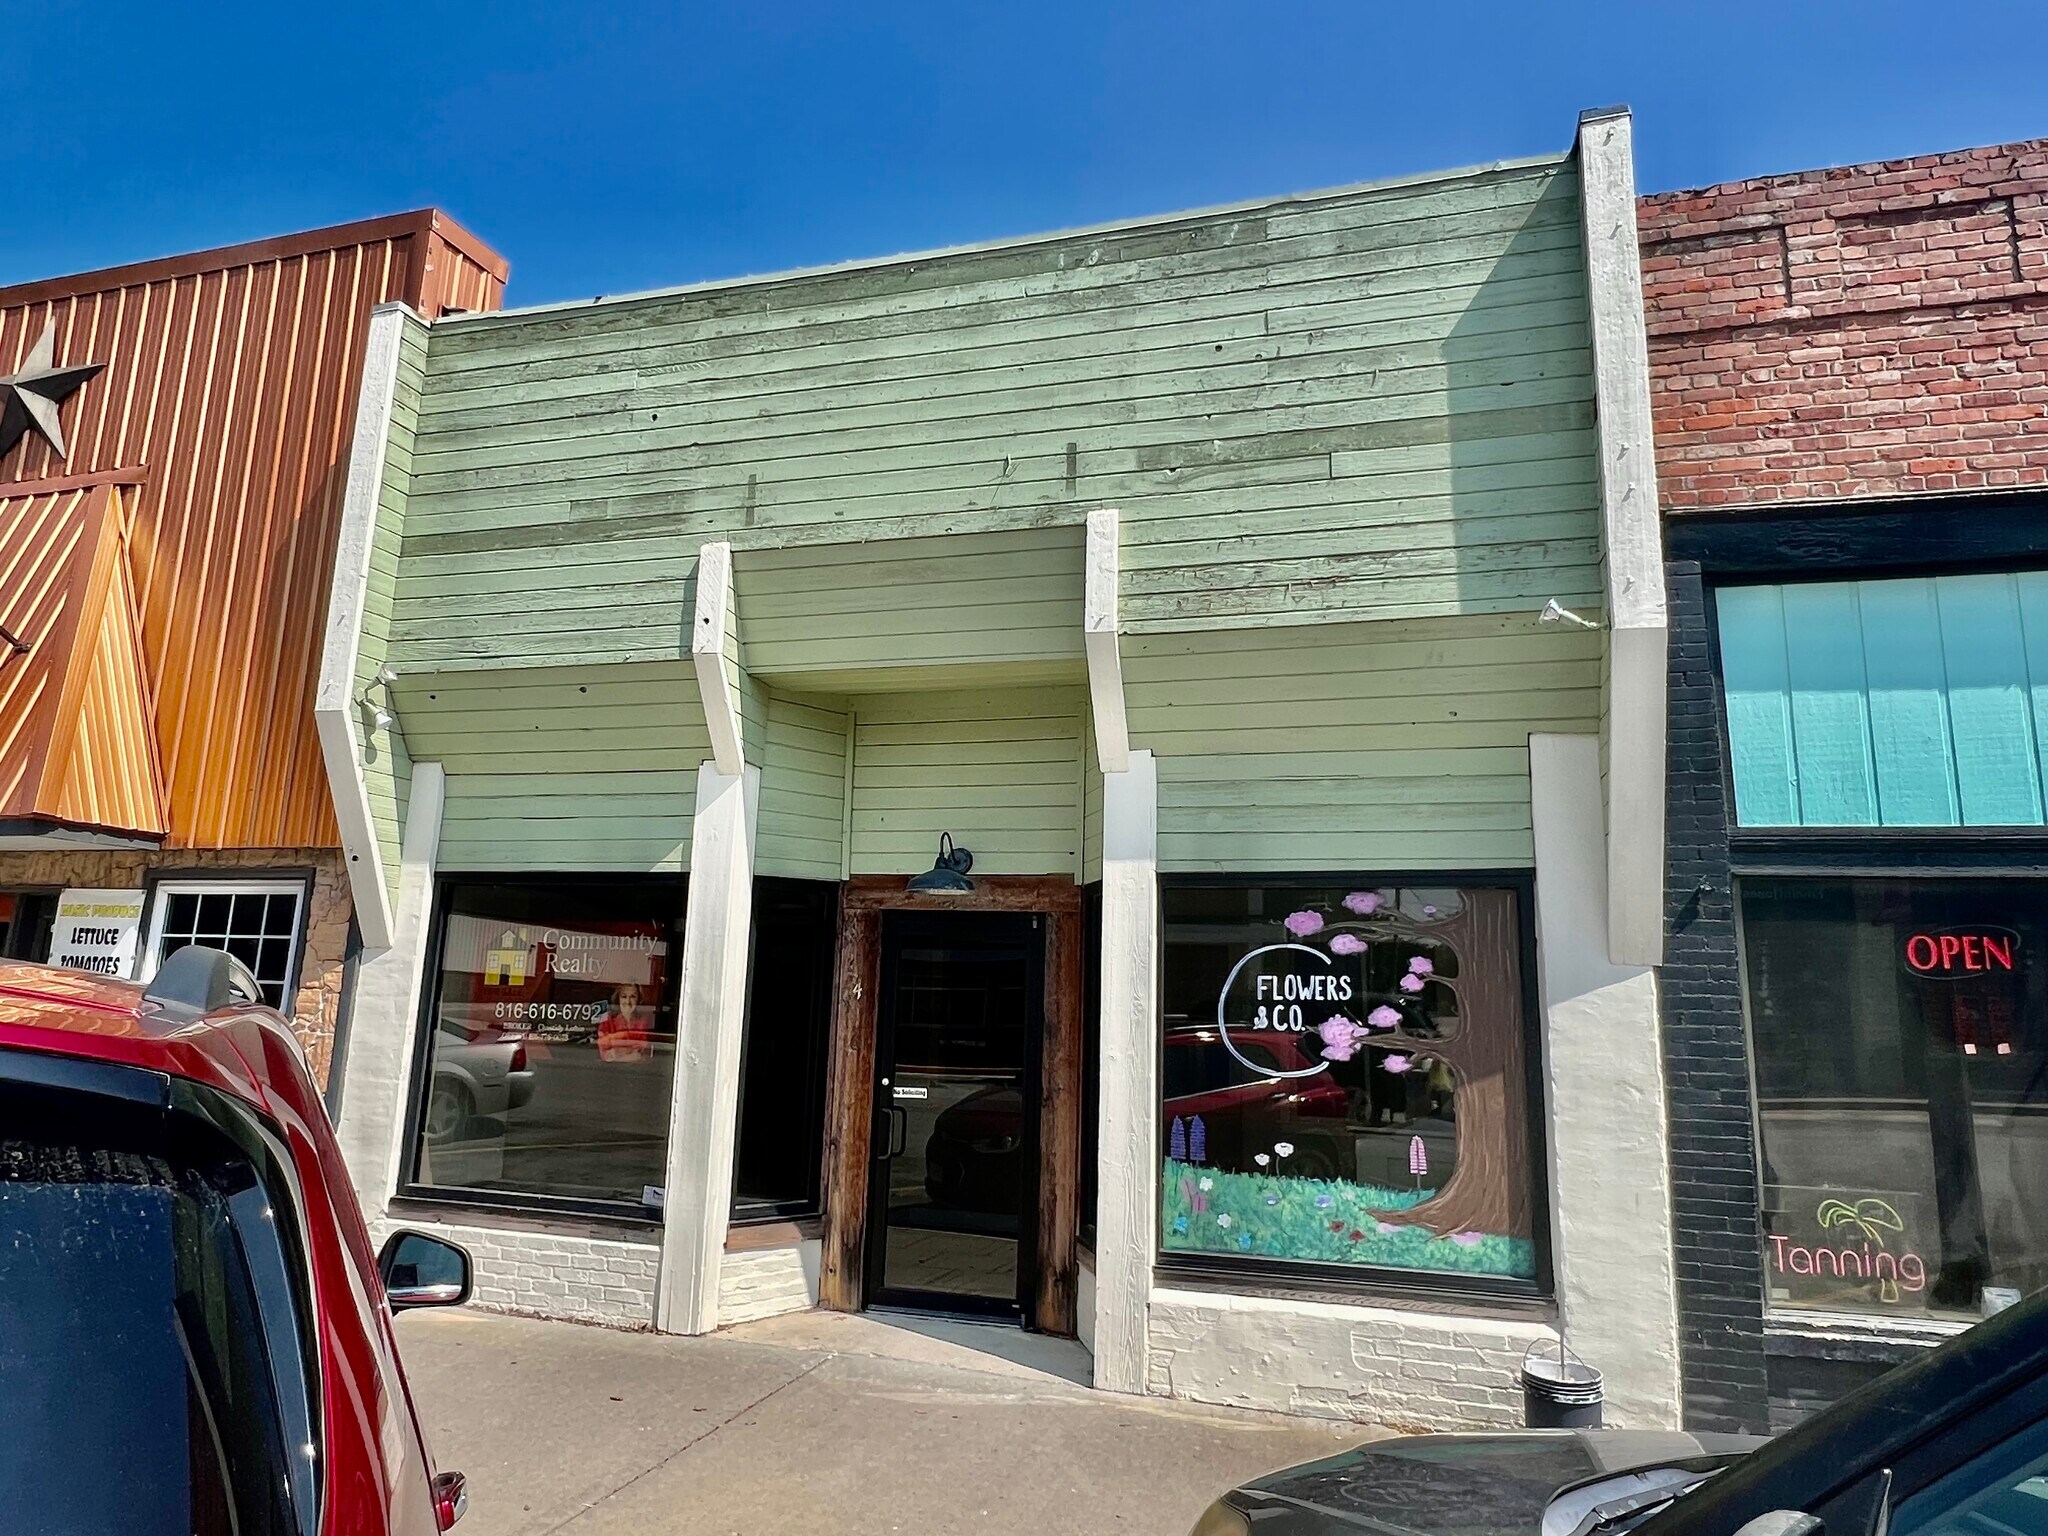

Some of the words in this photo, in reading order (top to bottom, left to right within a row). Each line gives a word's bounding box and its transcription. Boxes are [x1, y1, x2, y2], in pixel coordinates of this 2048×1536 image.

[71, 927, 119, 945] LETTUCE
[543, 929, 658, 956] Community
[61, 955, 120, 975] TOMATOES
[545, 952, 607, 979] Realty
[1907, 935, 2012, 970] OPEN
[1257, 974, 1352, 1001] FLOWERS
[495, 1002, 602, 1023] 816-616-6792
[1768, 1234, 1926, 1292] Tanning
